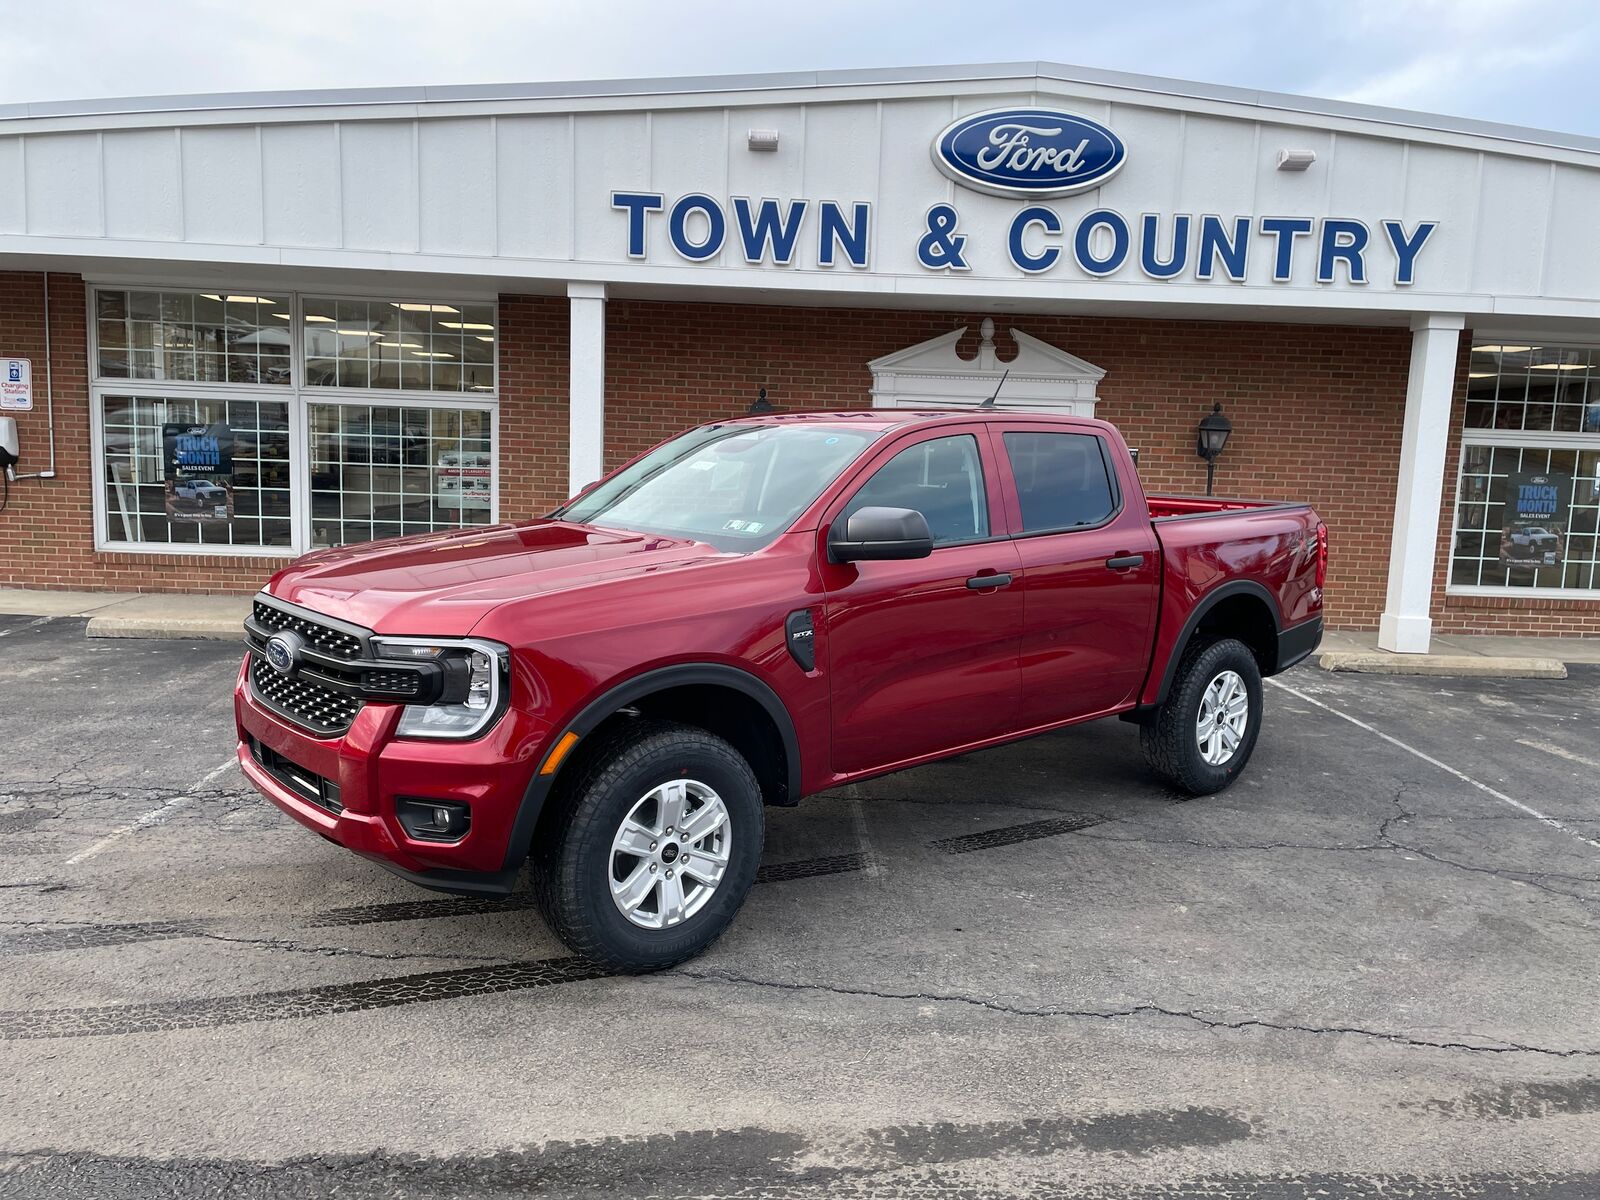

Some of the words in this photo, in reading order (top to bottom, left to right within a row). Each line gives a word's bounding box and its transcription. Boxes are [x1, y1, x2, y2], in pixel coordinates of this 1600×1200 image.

[977, 123, 1090, 173] Ford
[611, 191, 871, 268] TOWN
[917, 203, 972, 271] &
[1008, 206, 1439, 286] COUNTRY
[176, 435, 218, 451] TRUCK
[177, 451, 219, 464] MONTH
[1519, 485, 1557, 499] TRUCK
[1517, 499, 1556, 512] MONTH
